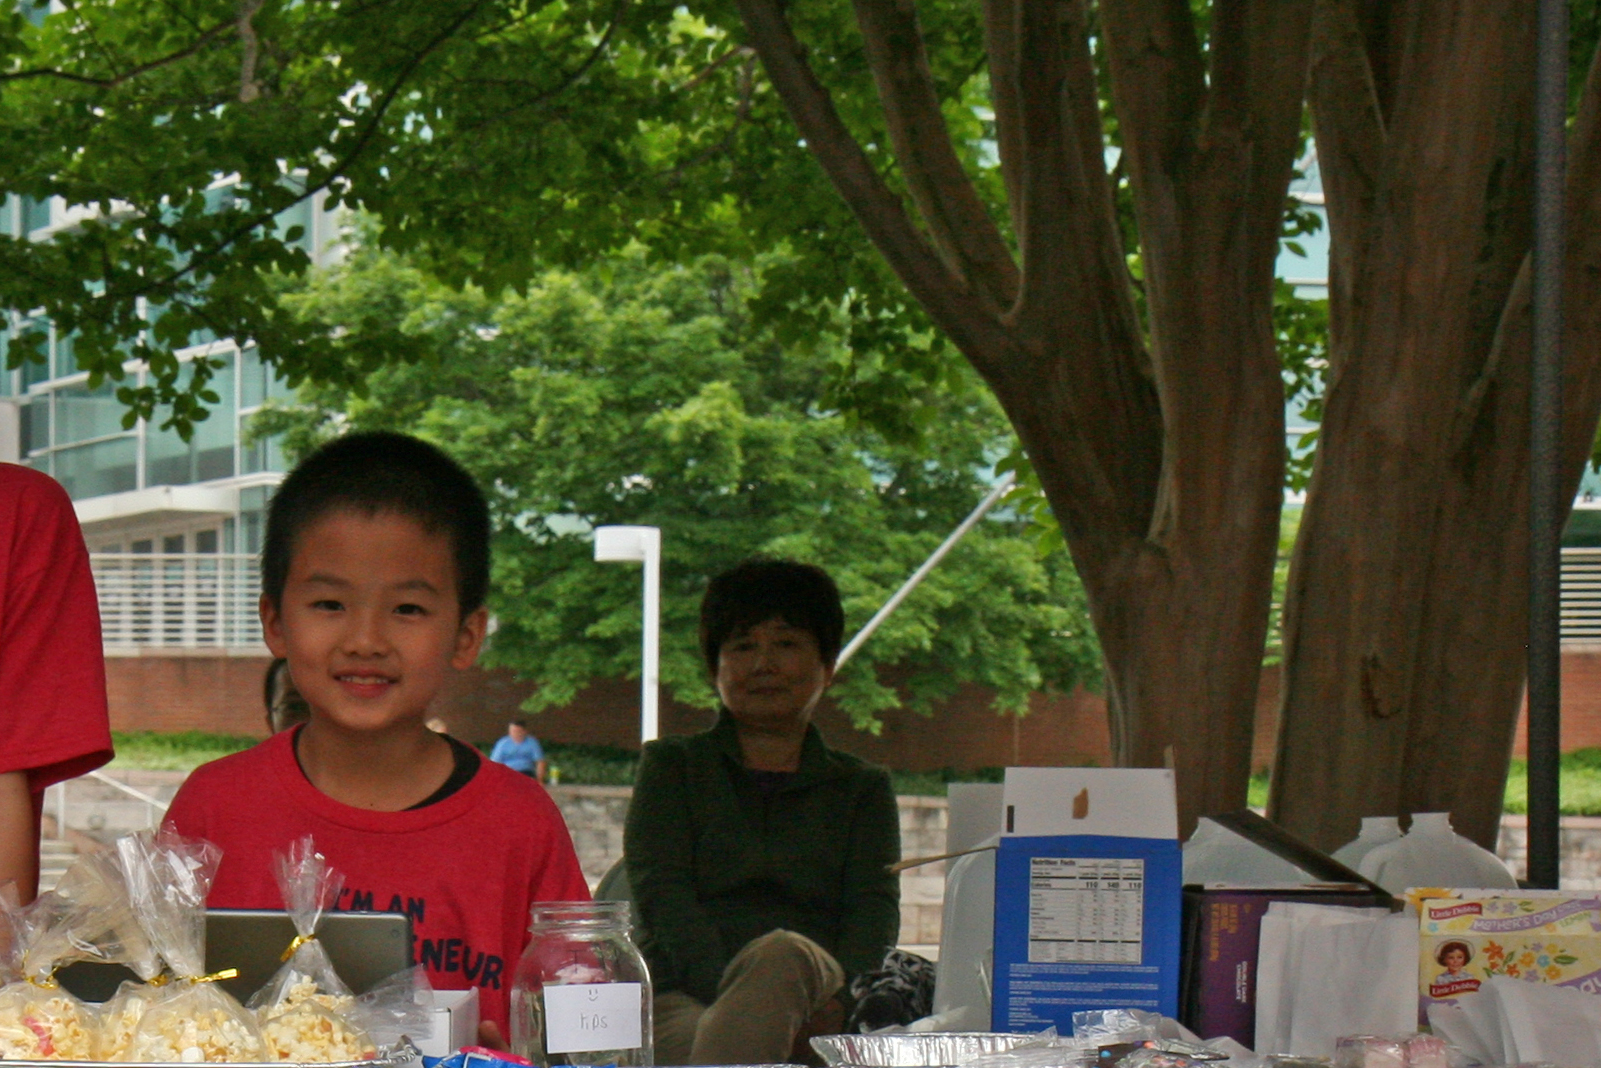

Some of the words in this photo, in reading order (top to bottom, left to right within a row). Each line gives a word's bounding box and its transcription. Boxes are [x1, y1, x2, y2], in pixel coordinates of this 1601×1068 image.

[1431, 908, 1450, 918] Little
[1452, 905, 1480, 916] Debbie
[1431, 985, 1450, 996] Little
[1452, 982, 1479, 993] Debbie
